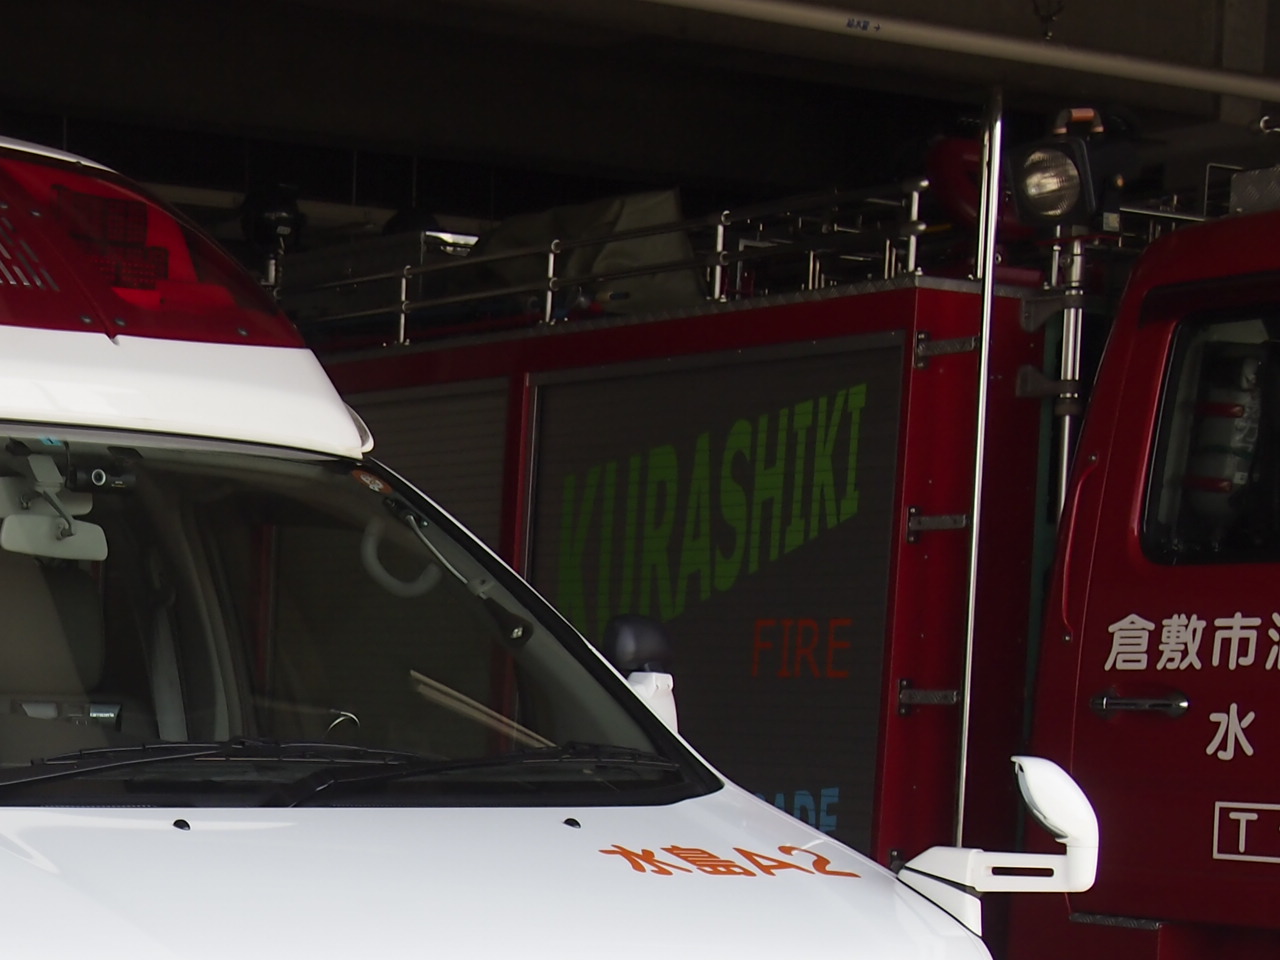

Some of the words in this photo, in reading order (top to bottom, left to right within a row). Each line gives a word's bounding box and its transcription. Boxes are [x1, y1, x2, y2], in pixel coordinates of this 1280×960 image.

[558, 383, 867, 648] KURASHIKI
[751, 617, 854, 679] FIRE
[1104, 611, 1280, 672] 倉敷市
[1205, 702, 1256, 761] 水
[598, 844, 862, 878] 水島A2
